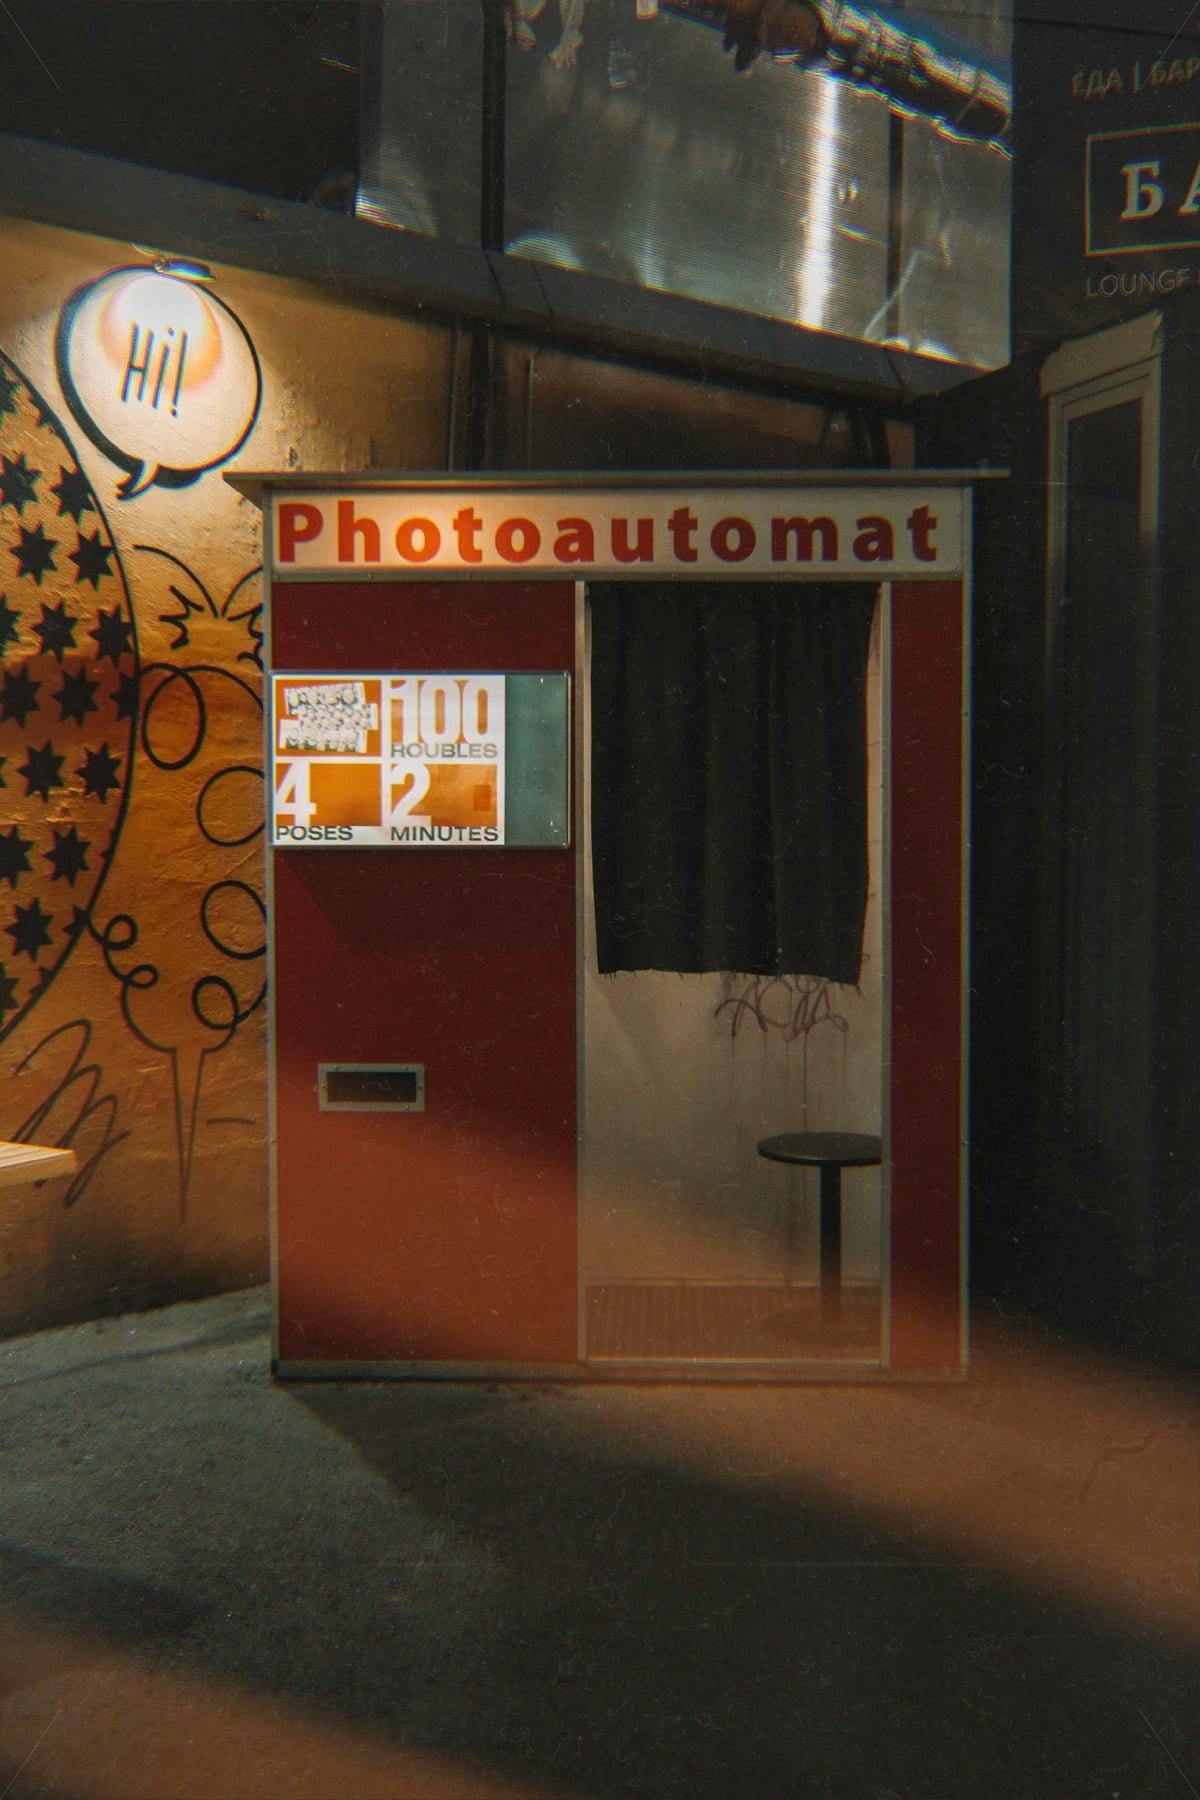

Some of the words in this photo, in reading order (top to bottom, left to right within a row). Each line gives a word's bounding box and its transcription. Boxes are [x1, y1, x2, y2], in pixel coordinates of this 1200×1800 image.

[118, 318, 189, 419] Hi!
[277, 499, 938, 564] Photoautomat
[391, 677, 501, 743] 100
[391, 742, 498, 758] ROUBLES
[274, 762, 317, 826] 4
[390, 762, 432, 826] 2
[275, 825, 354, 842] POSES
[390, 825, 499, 842] MINUTES
